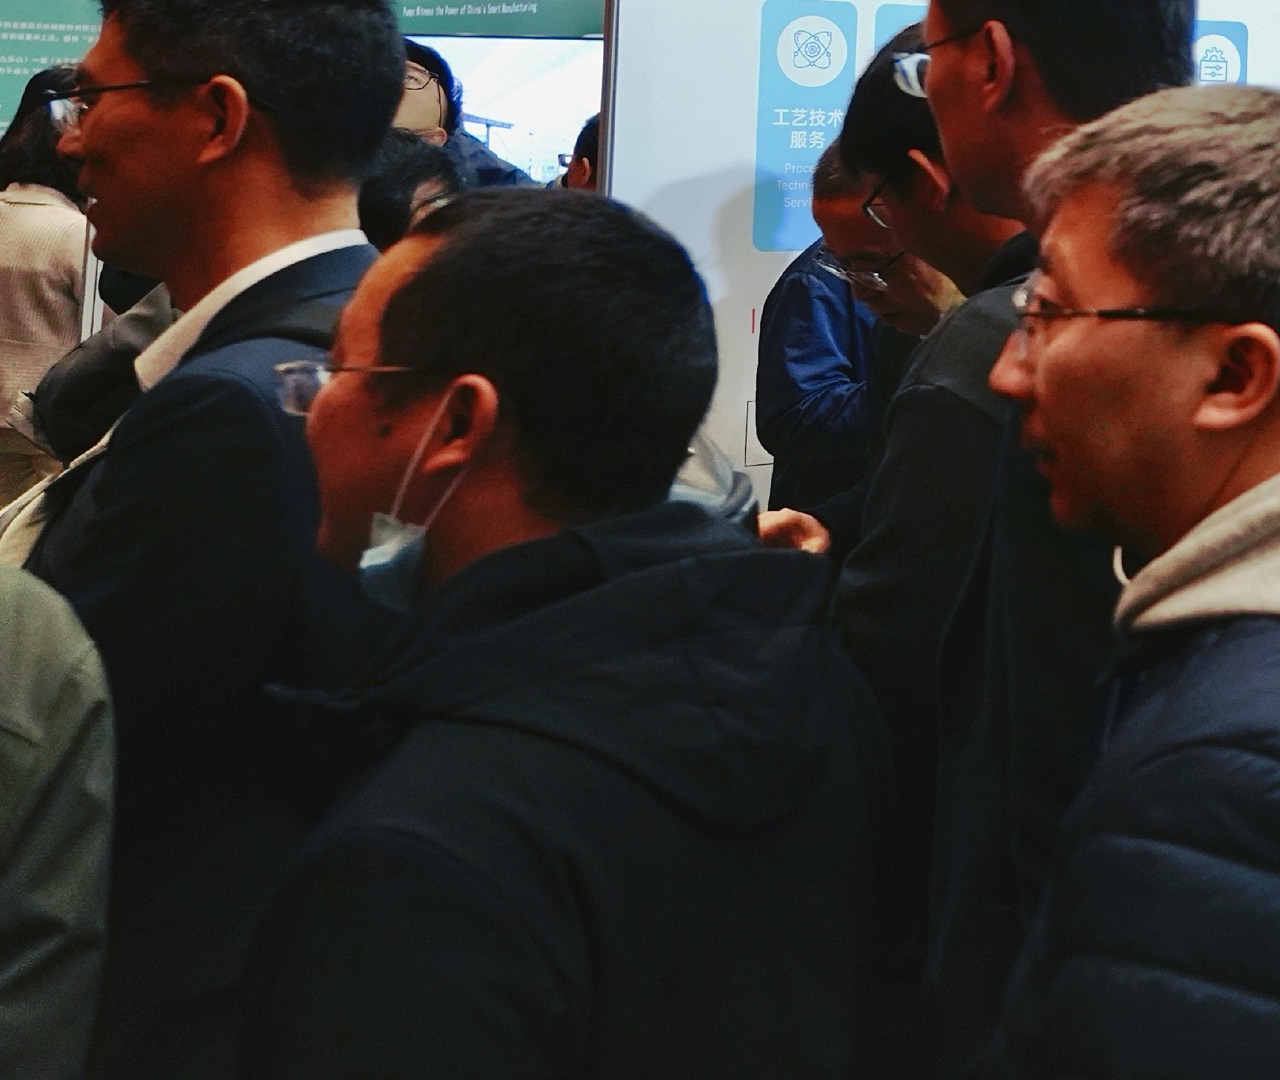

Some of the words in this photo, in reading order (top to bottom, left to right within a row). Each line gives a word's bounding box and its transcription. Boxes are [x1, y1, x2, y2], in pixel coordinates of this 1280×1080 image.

[772, 107, 844, 128] 工艺技术
[789, 130, 826, 149] 服务
